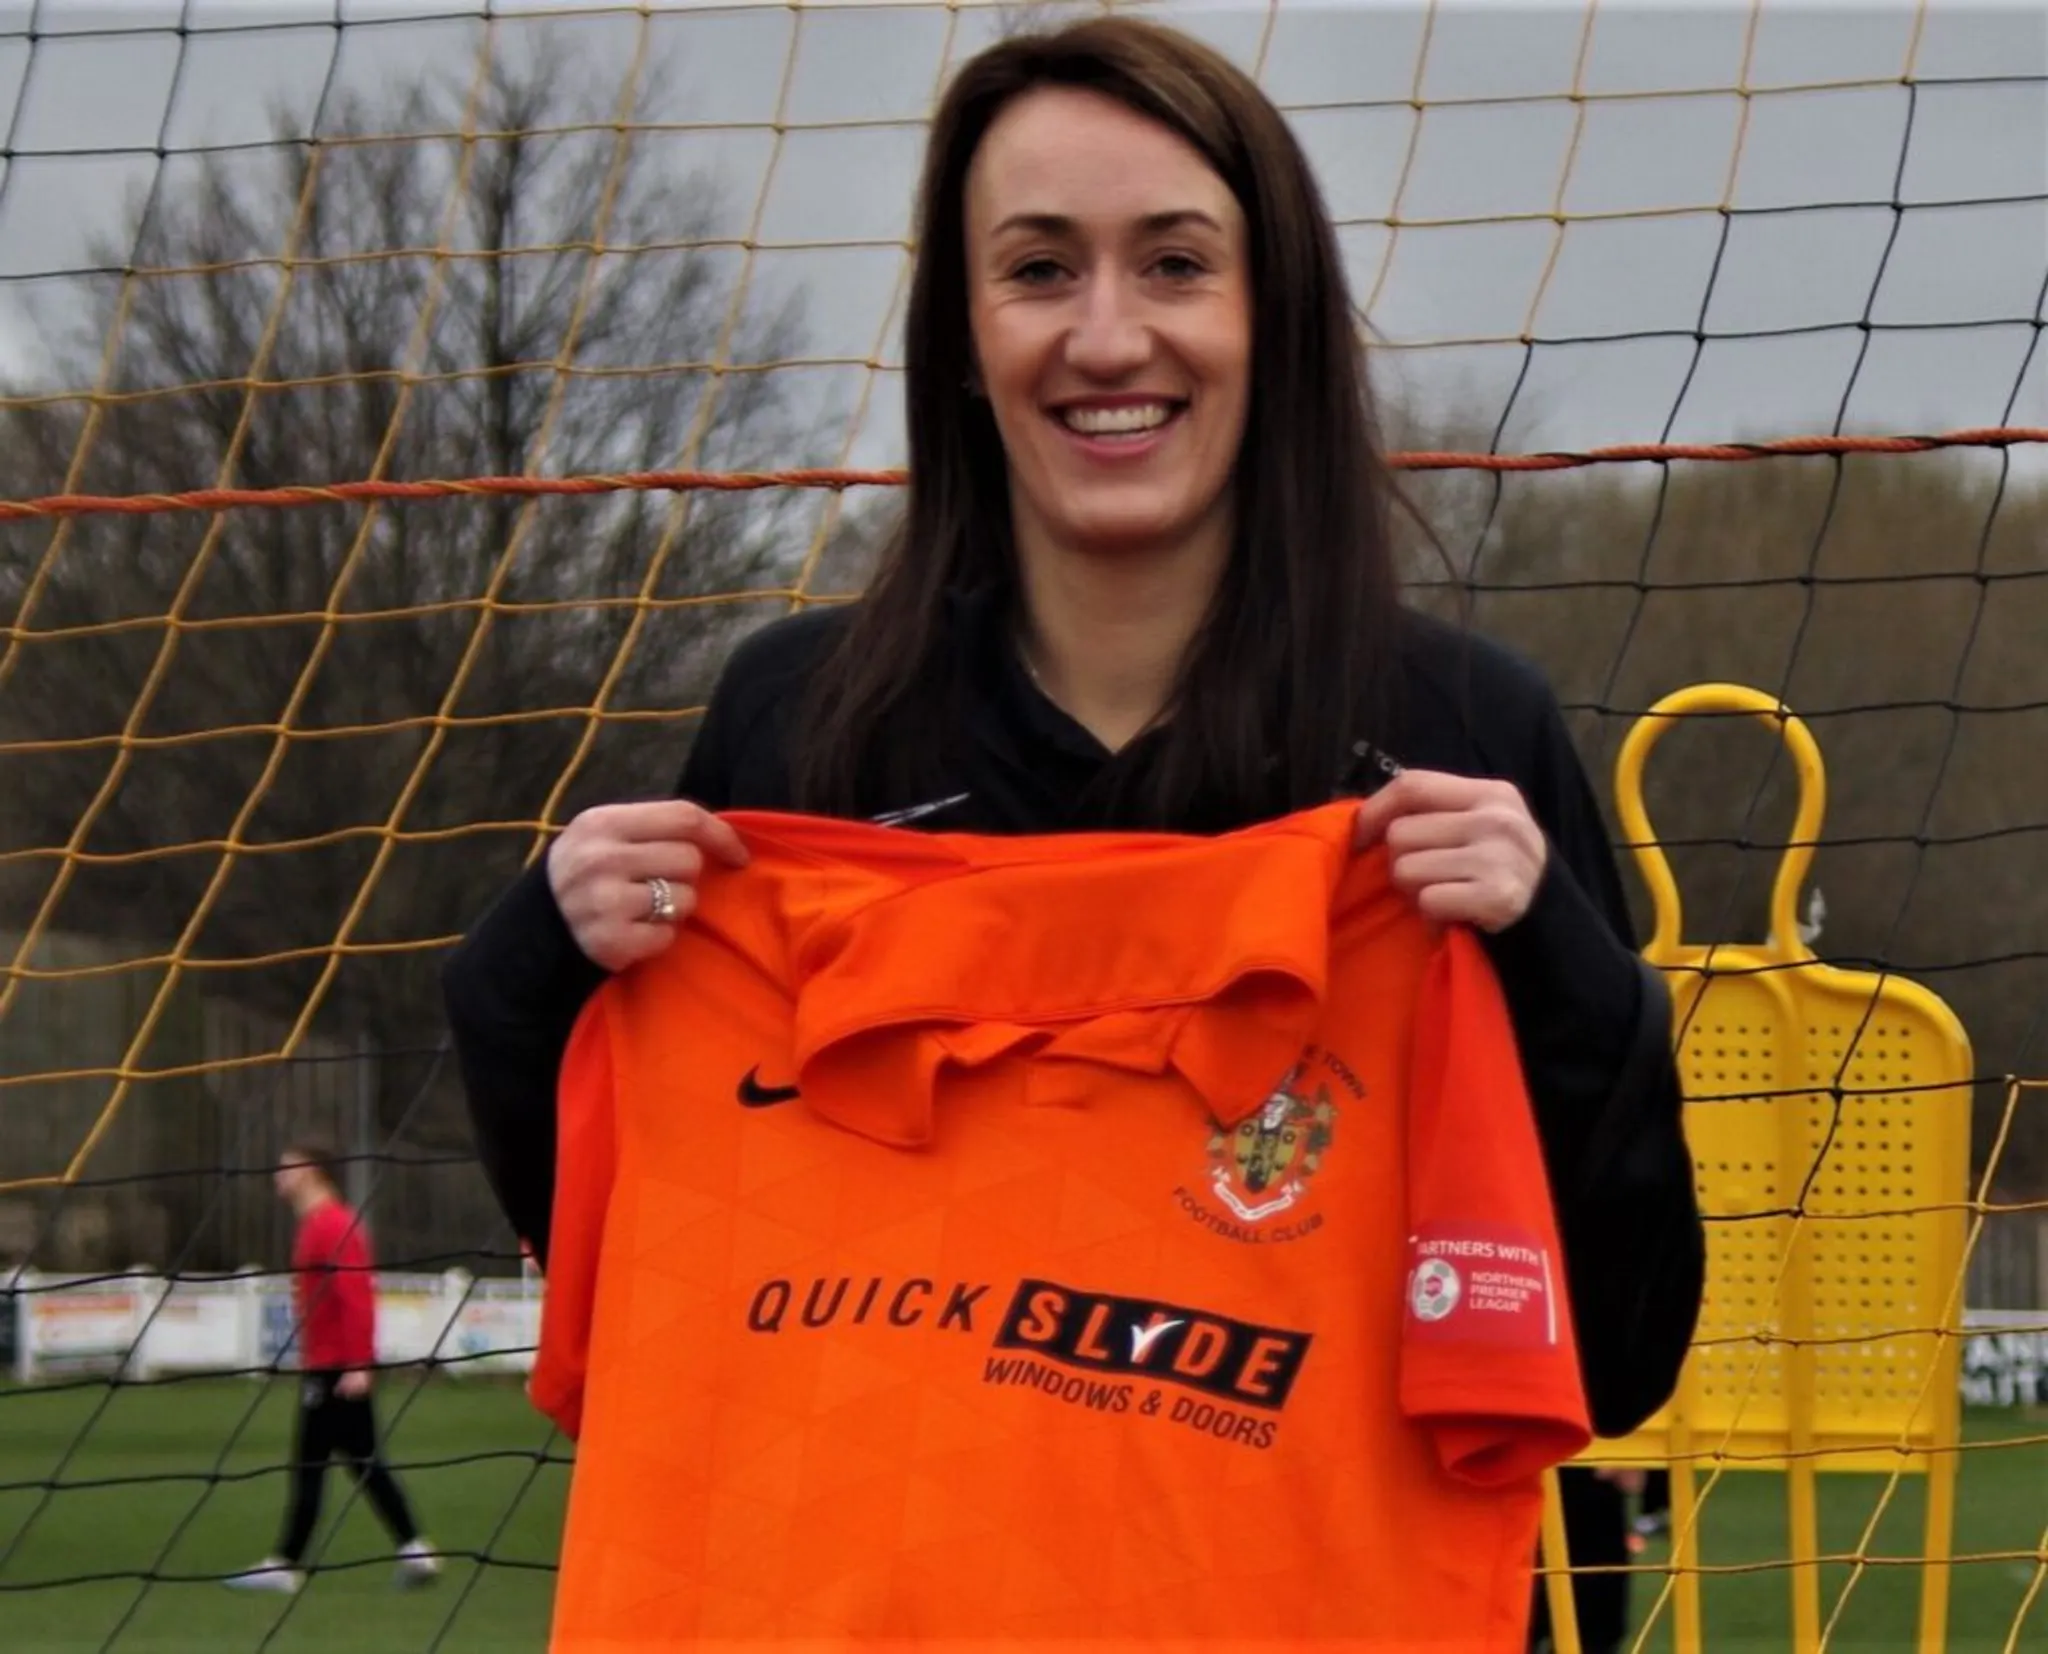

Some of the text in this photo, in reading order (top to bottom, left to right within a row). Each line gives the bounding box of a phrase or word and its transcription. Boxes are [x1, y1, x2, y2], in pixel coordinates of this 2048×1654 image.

[1322, 1049, 1367, 1101] TOWN
[1173, 1186, 1263, 1244] FOOTBALL
[1271, 1212, 1324, 1243] CLUB
[1416, 1239, 1540, 1267] ARTNERS WITH
[1470, 1283, 1530, 1302] PREMIER
[1471, 1271, 1543, 1292] NORTHERN
[1469, 1298, 1522, 1313] LEAGUE
[747, 1277, 1290, 1396] QUICK SLYDE
[982, 1357, 1278, 1450] WINDOWS & DOORS
